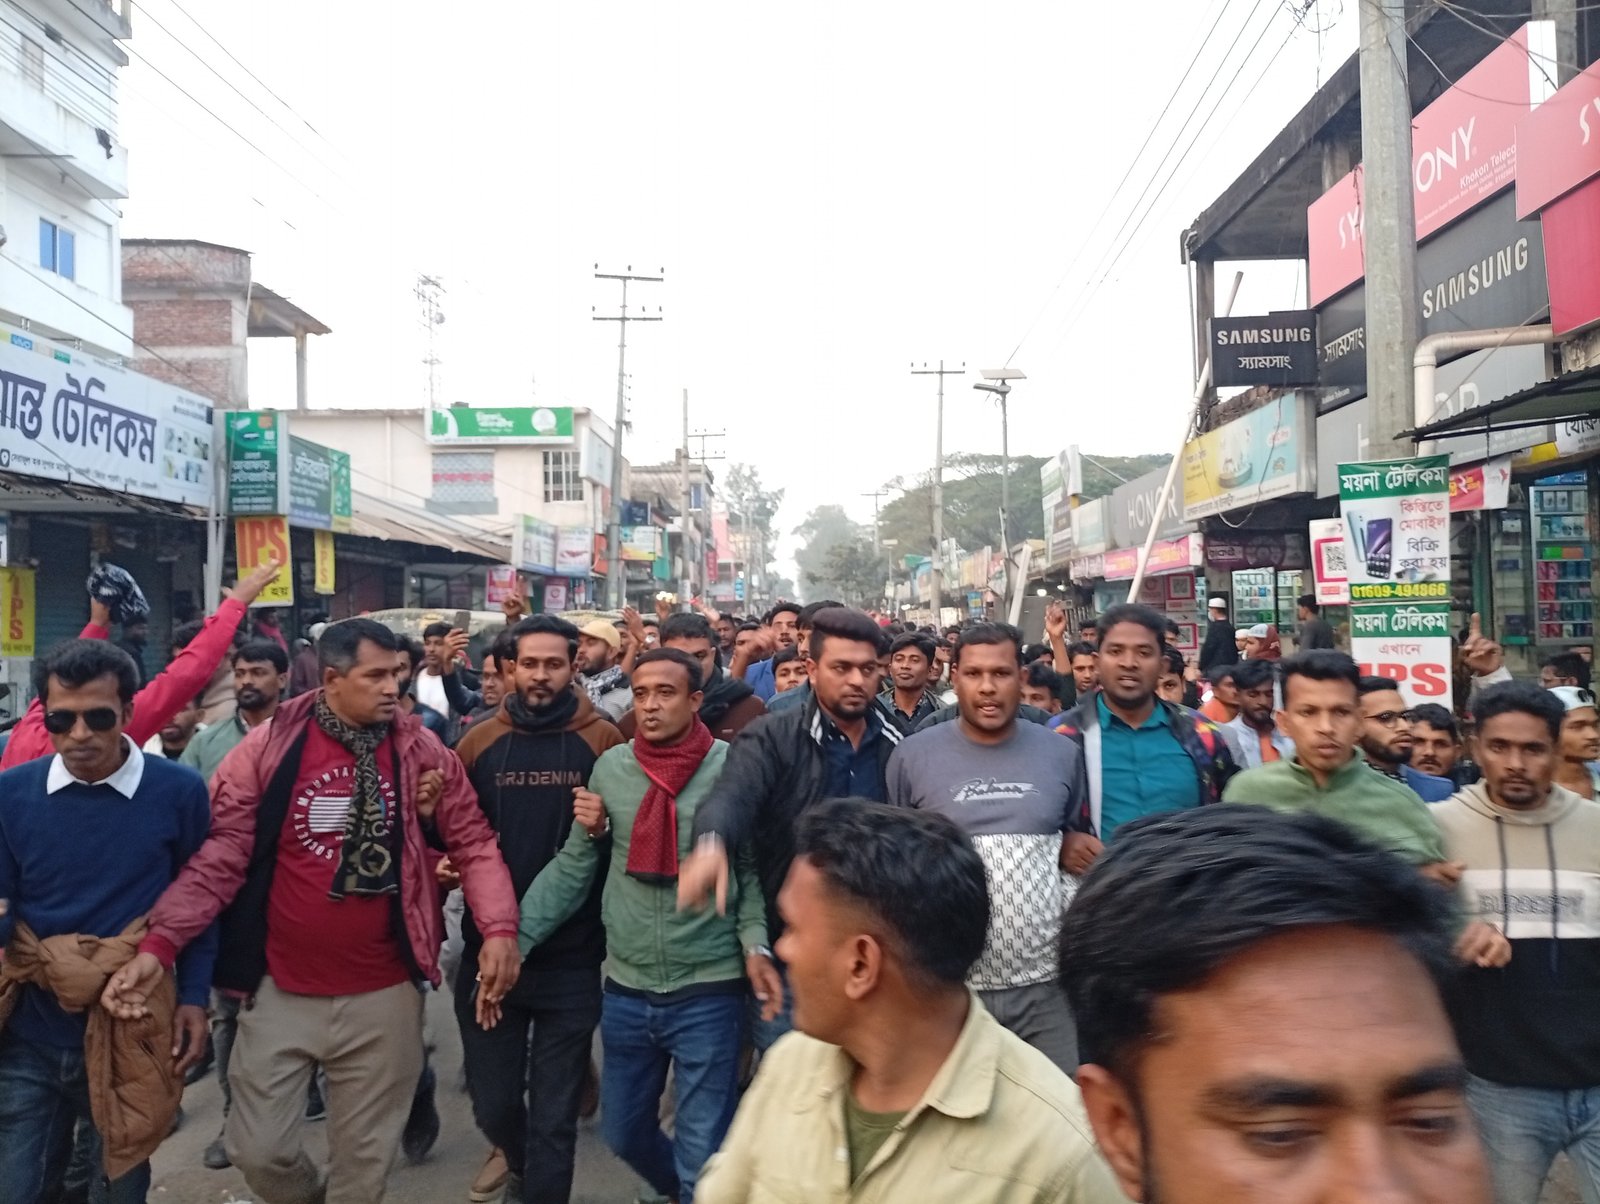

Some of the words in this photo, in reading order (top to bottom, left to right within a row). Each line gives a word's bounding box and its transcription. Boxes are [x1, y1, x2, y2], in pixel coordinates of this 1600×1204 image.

[1460, 162, 1489, 189] Khokon
[1422, 237, 1529, 319] SAMSUNG
[1217, 327, 1311, 345] SAMSUNG
[1324, 327, 1364, 362] স্যামসাং
[1238, 355, 1293, 370] স্যামসাং
[53, 373, 157, 464] টেলিকম
[1340, 470, 1381, 493] ময়না
[1385, 463, 1447, 489] টেলিকম
[1400, 498, 1445, 514] কিস্তিতে
[1400, 515, 1447, 531] মোবাইল
[237, 518, 288, 568] IPS
[1407, 537, 1440, 553] বিক্রি
[1428, 556, 1448, 571] হয়
[1353, 611, 1389, 633] ময়না
[1391, 606, 1449, 633] টেলিকম
[1378, 643, 1423, 656] এখানে
[296, 766, 357, 807] MOUNTAI
[528, 771, 582, 786] DENIM
